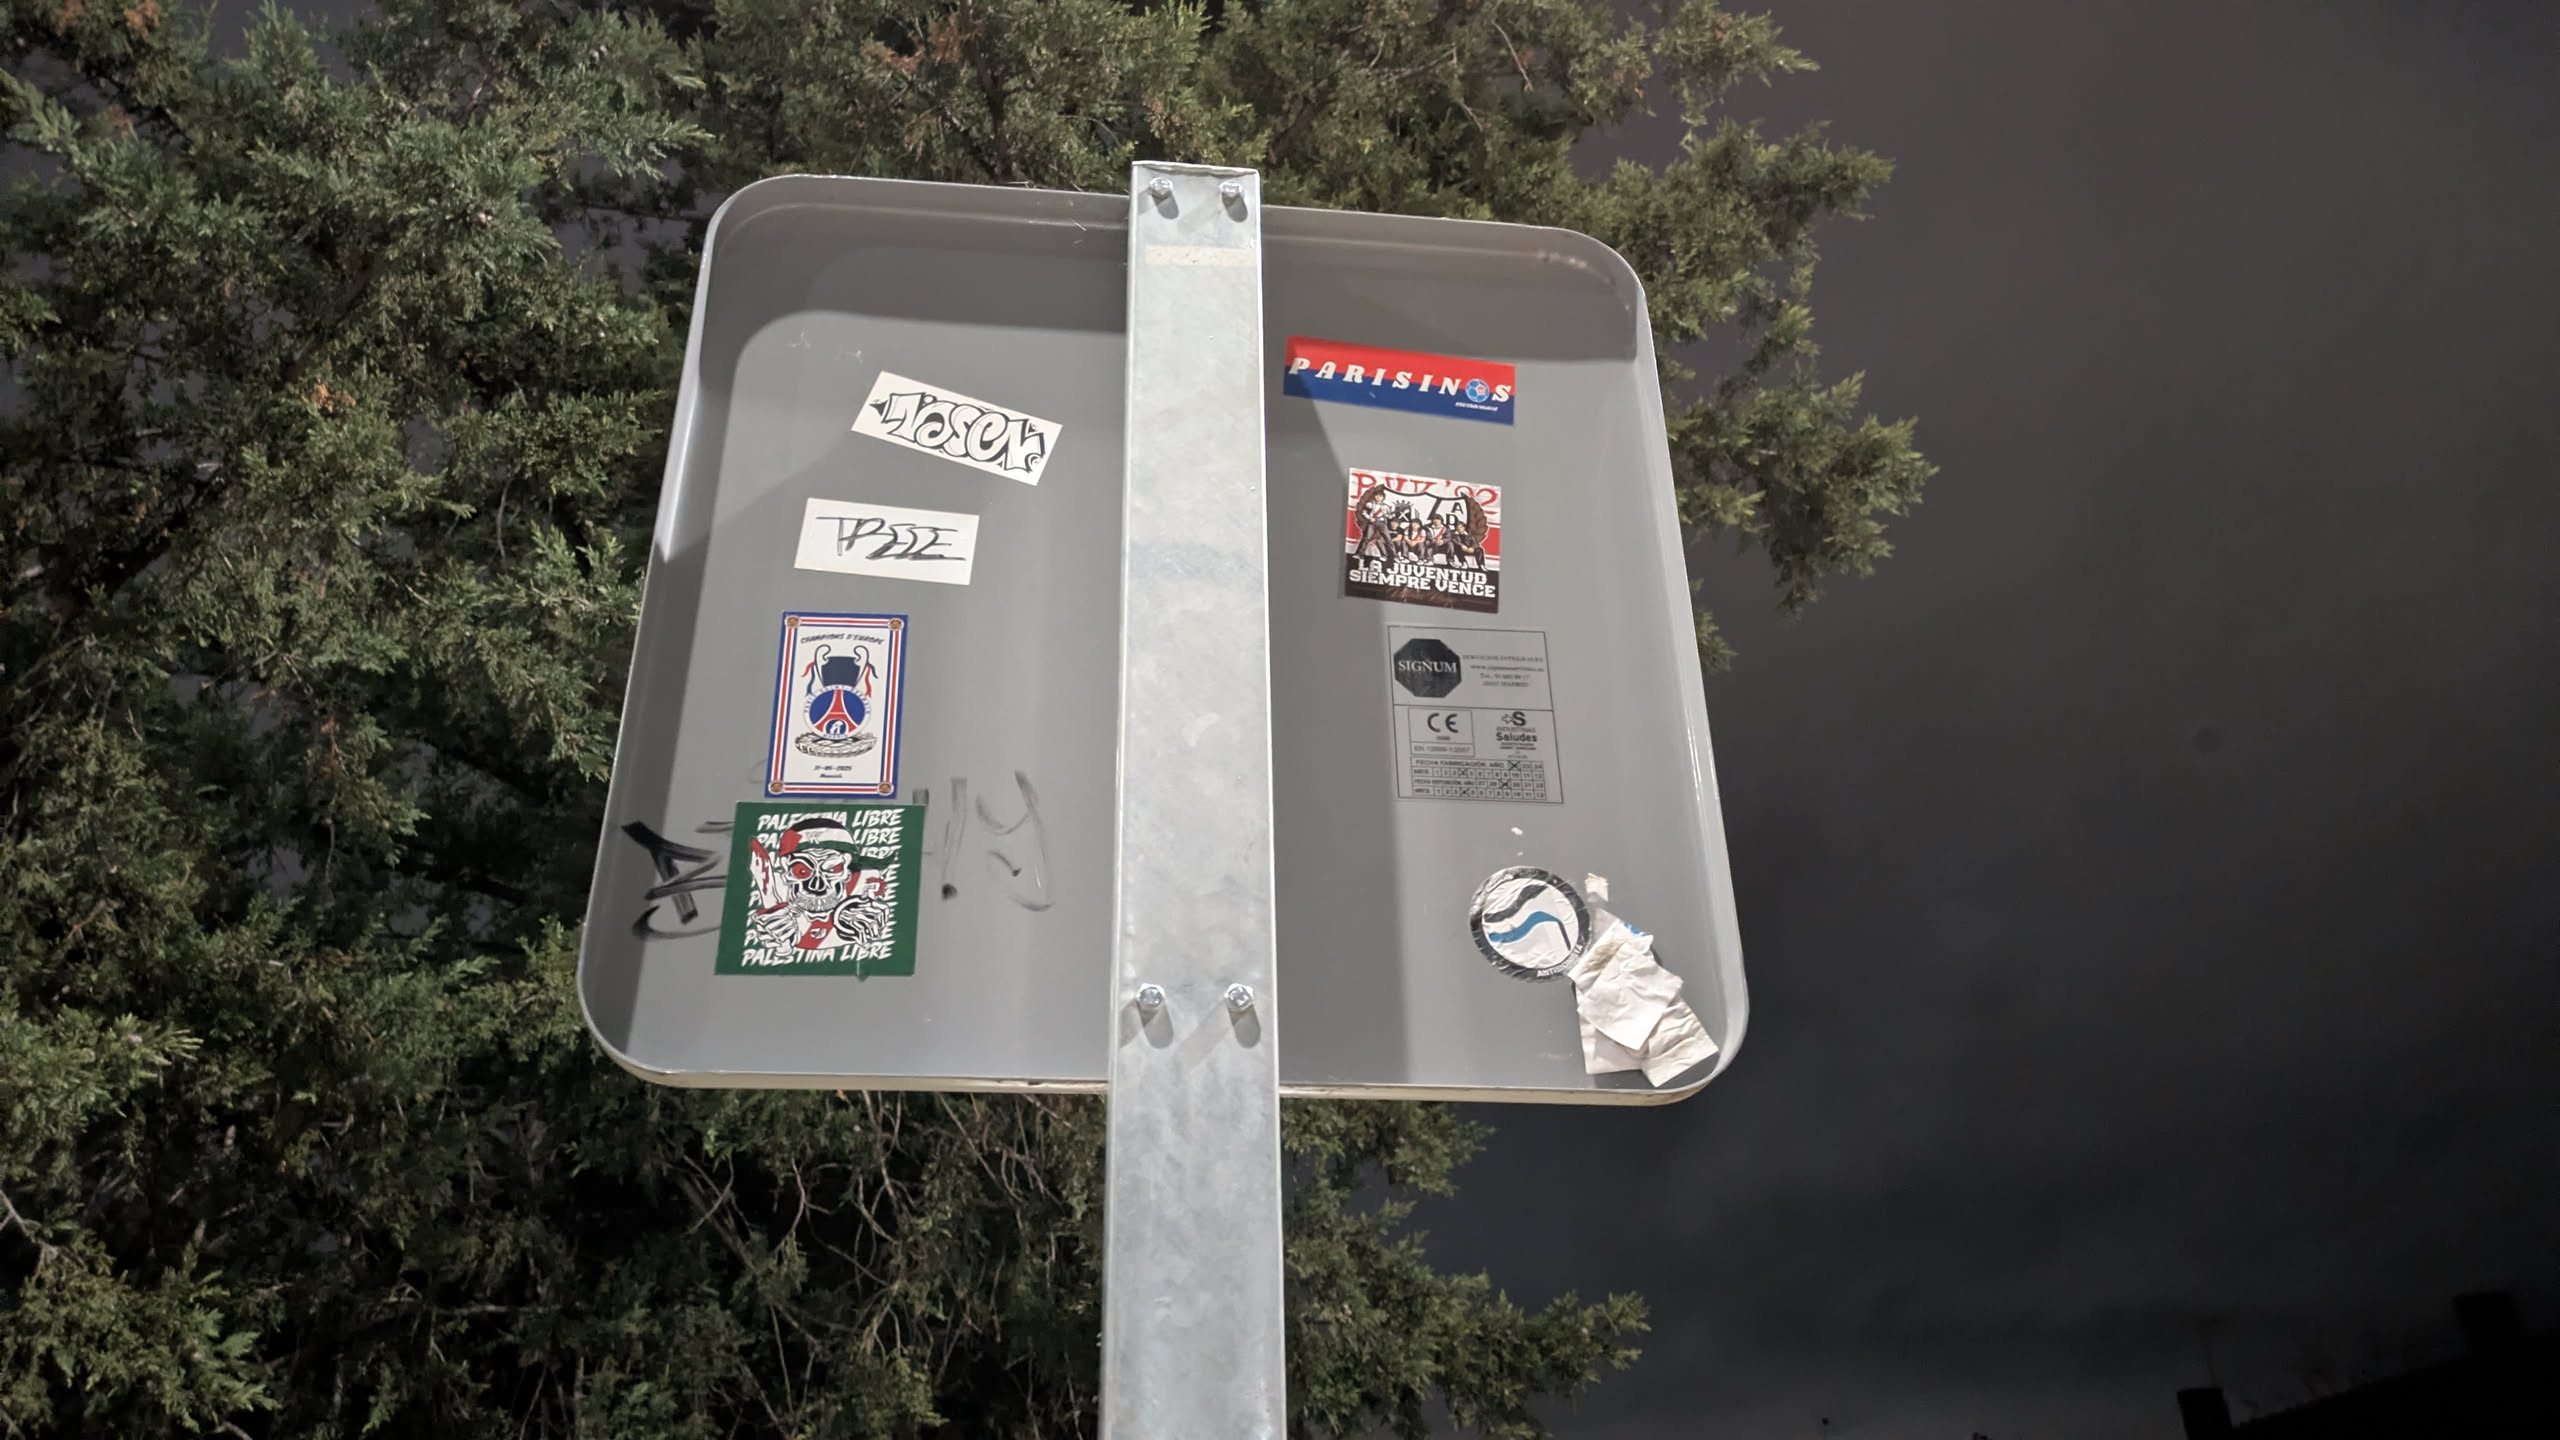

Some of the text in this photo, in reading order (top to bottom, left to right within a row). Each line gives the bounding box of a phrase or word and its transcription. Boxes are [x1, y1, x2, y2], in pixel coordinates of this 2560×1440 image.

[1288, 357, 1512, 403] PARISINOS
[1358, 559, 1487, 585] LA JUVENTUD
[1349, 569, 1496, 598] SIEMPRE VENCE
[1398, 660, 1458, 673] SIGNUM
[1496, 731, 1537, 742] Saludes
[851, 808, 904, 828] LIBRE
[839, 941, 896, 962] LIBRE
